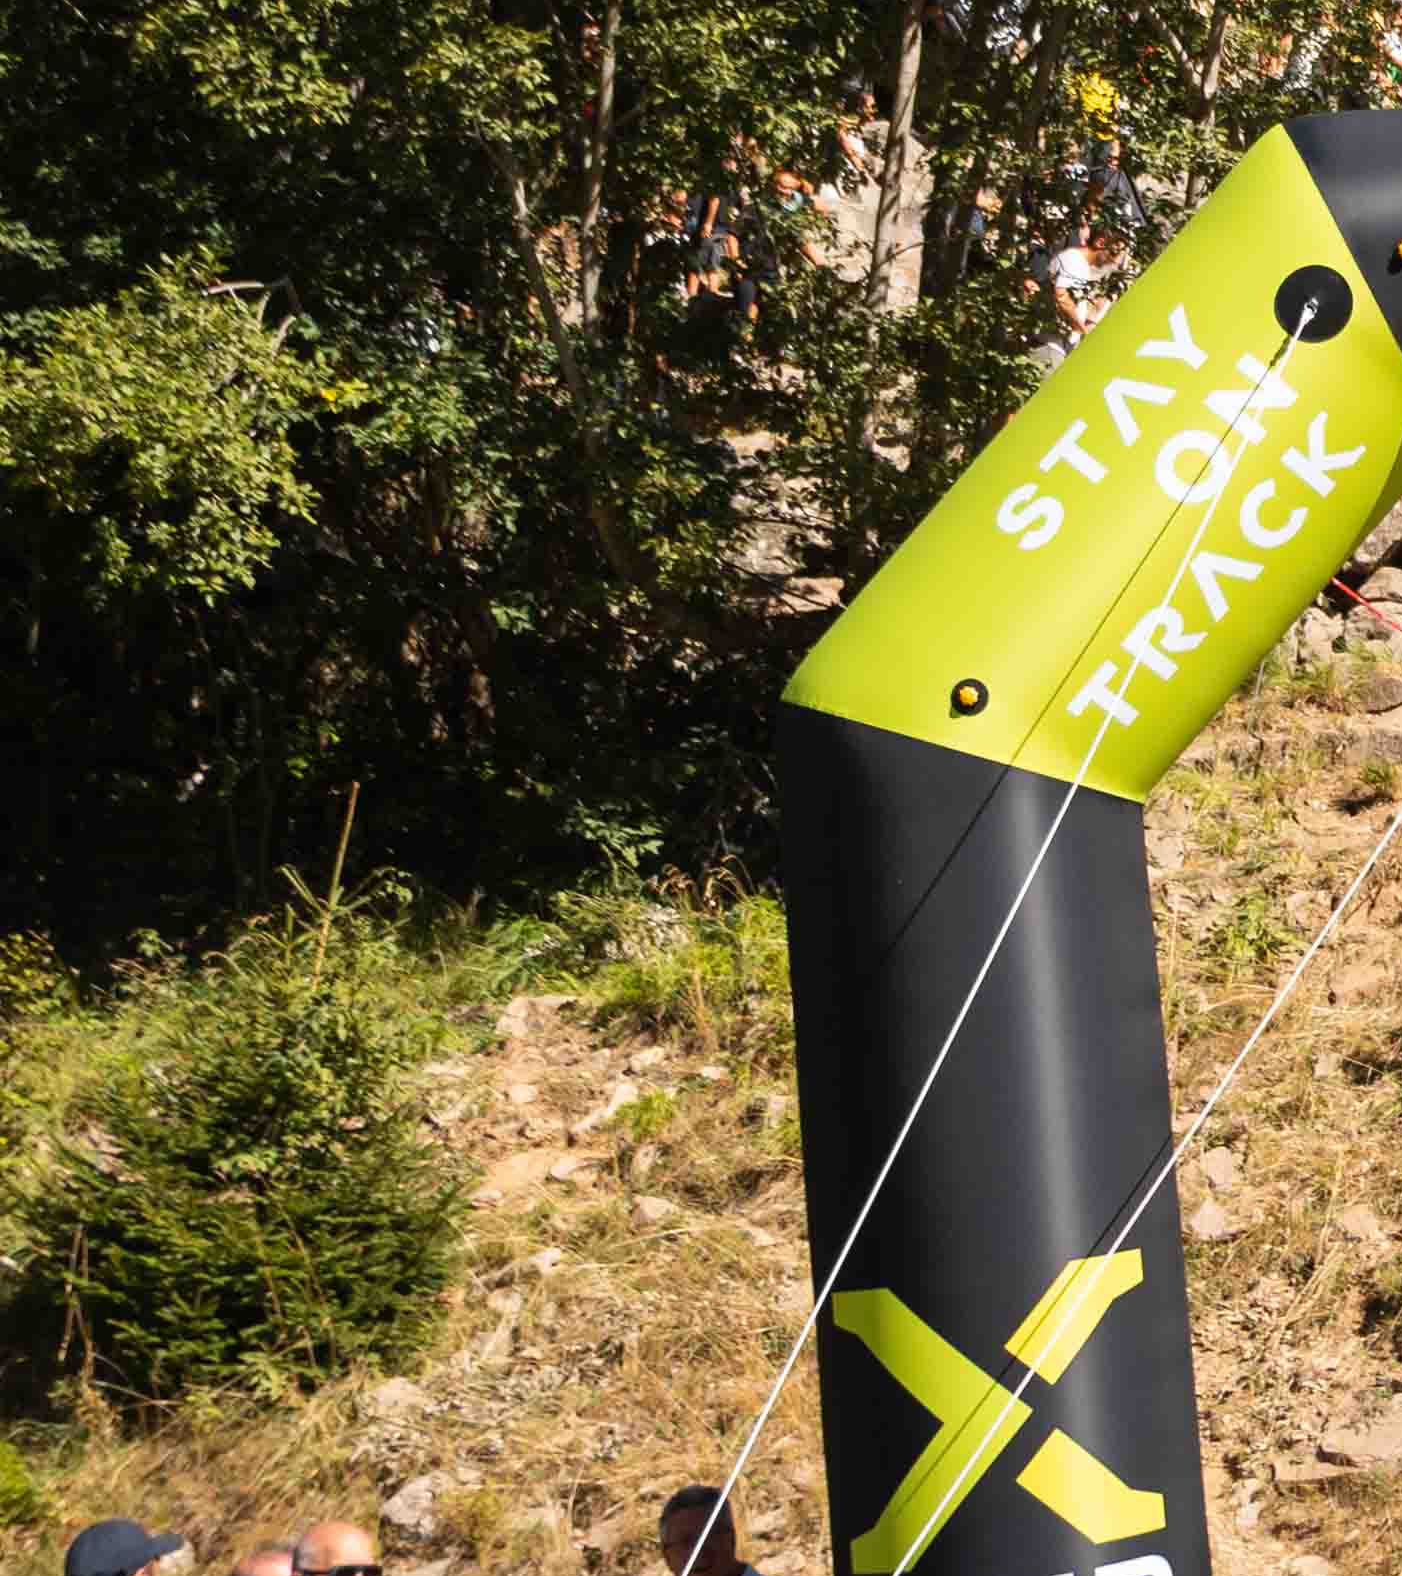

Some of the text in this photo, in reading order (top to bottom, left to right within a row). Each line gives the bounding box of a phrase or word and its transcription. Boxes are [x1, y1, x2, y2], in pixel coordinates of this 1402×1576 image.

[995, 303, 1208, 550] STAY
[1153, 353, 1298, 506] ON
[1067, 411, 1367, 726] TRACK
